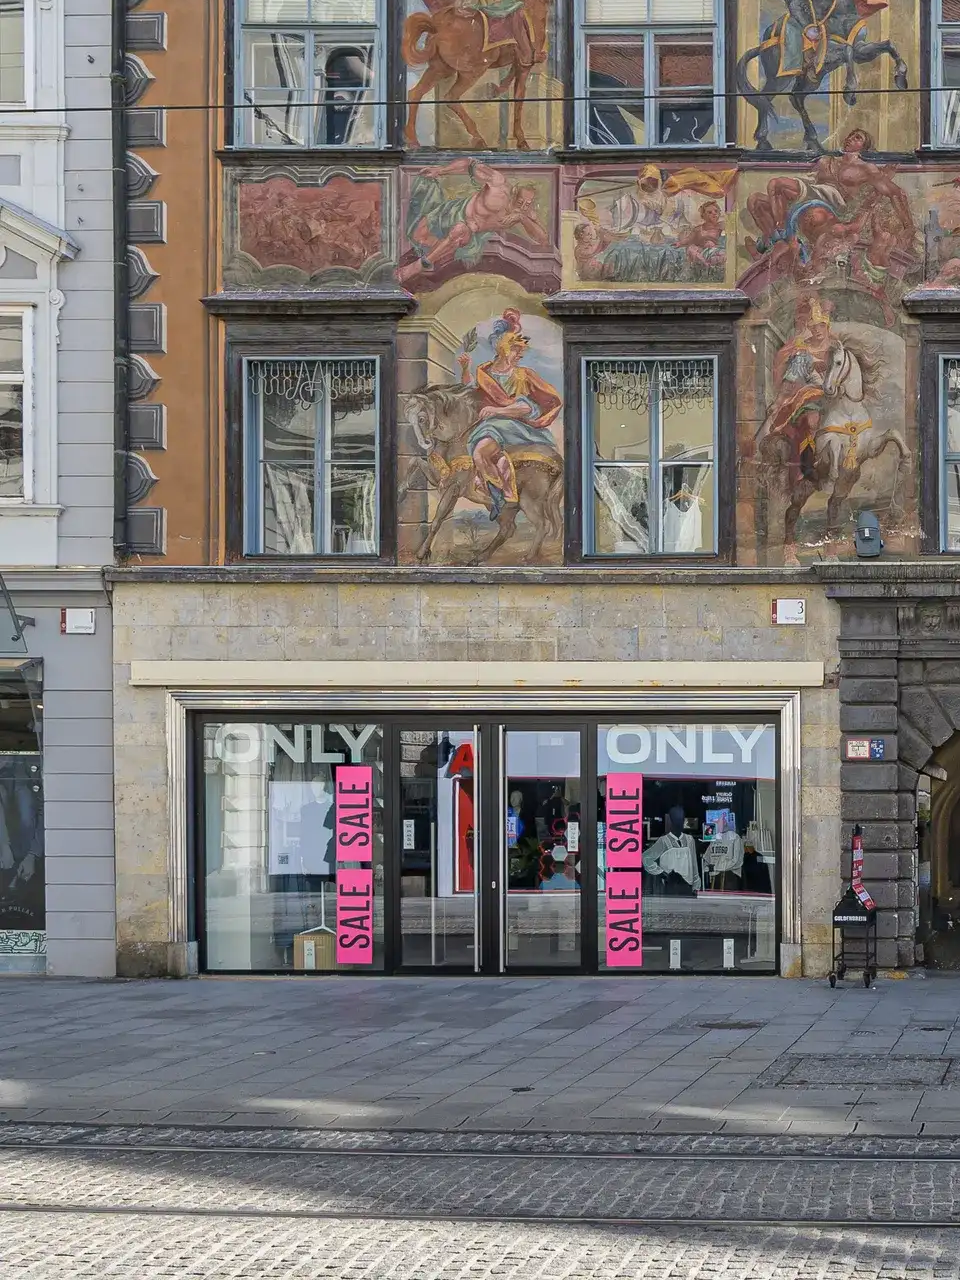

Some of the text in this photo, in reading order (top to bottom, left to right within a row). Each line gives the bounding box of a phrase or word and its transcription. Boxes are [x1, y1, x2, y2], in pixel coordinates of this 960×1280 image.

[797, 601, 804, 615] 3
[215, 723, 377, 763] ONLY
[606, 724, 769, 764] ONLY
[338, 782, 370, 847] SALE
[609, 788, 640, 853] SALE
[339, 884, 370, 949] SALE
[608, 887, 640, 952] SALE
